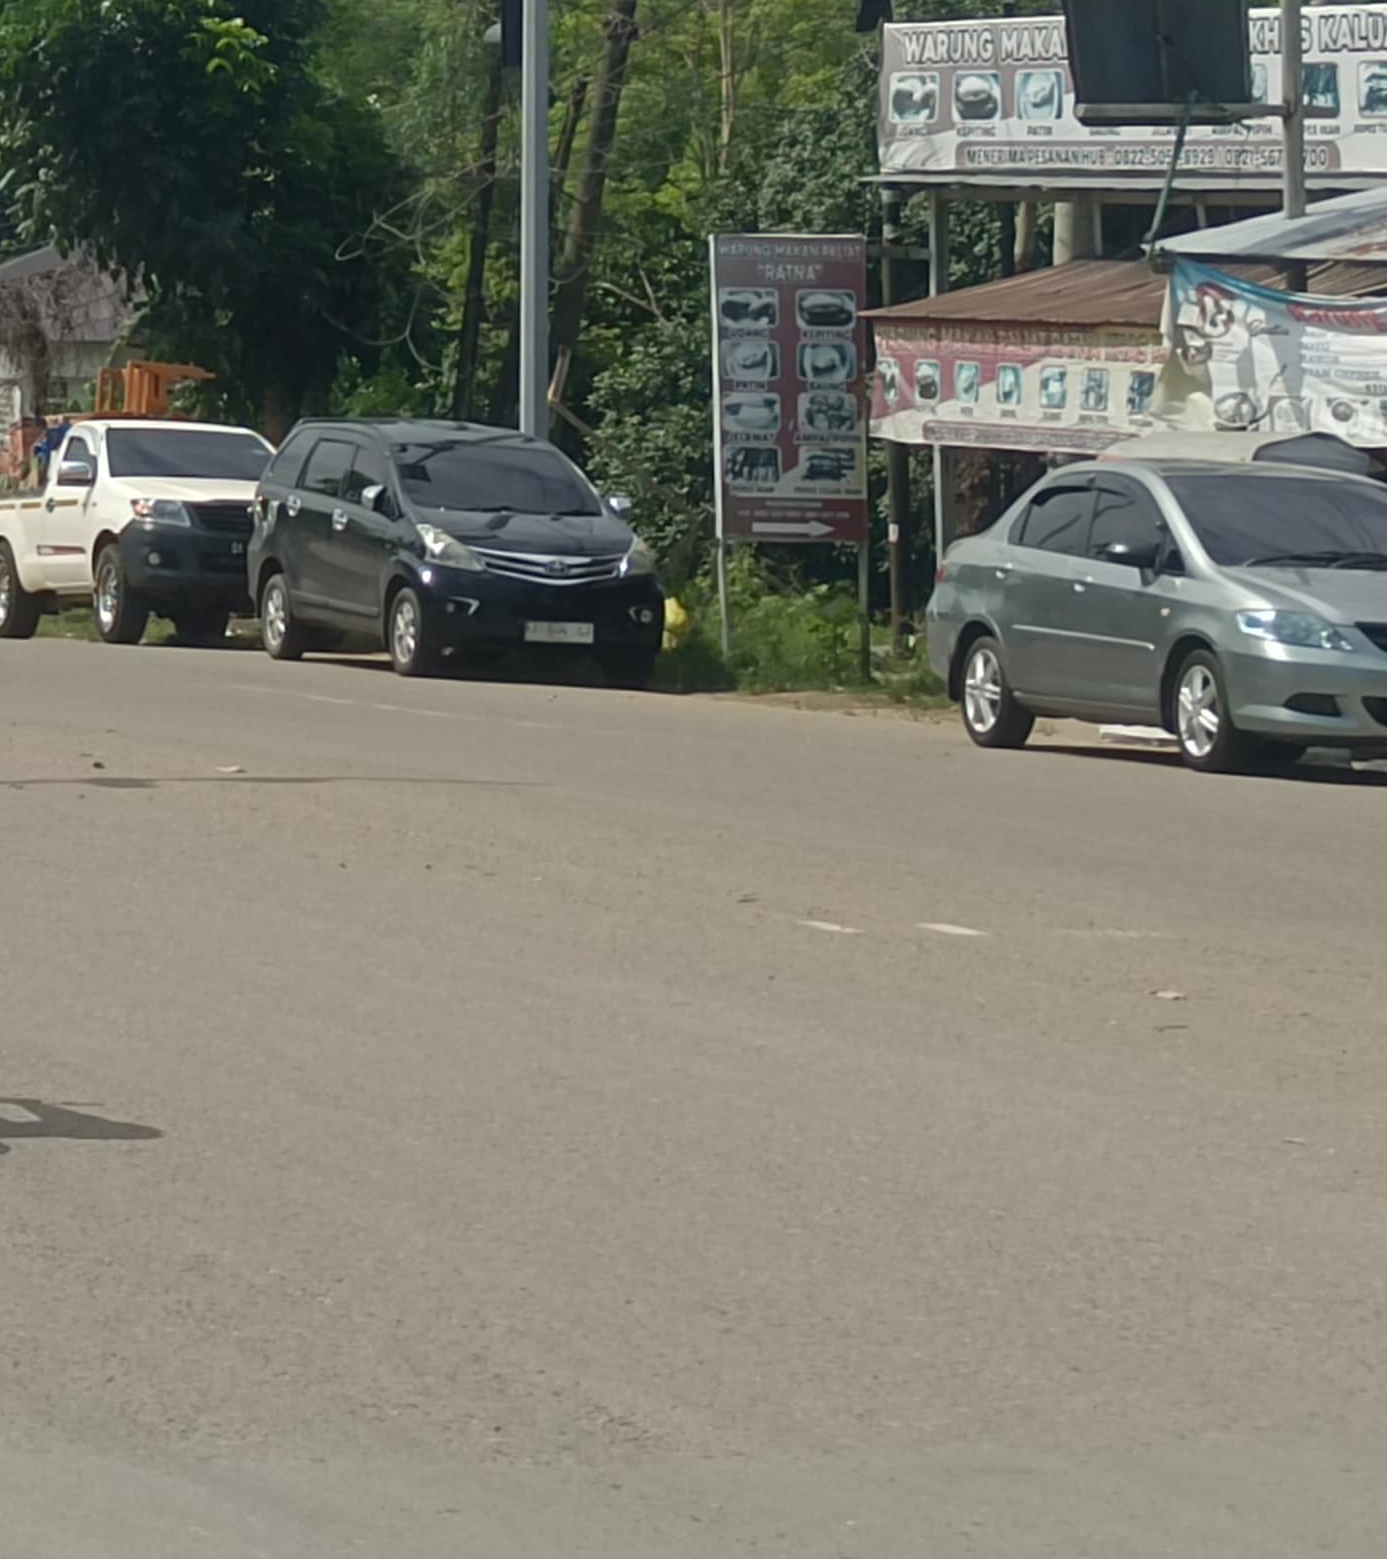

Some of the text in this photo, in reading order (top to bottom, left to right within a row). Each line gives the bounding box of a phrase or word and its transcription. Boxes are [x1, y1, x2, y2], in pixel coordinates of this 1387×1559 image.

[903, 28, 994, 64] WARUNG
[999, 25, 1069, 62] MAKA
[1318, 12, 1387, 52] KALU
